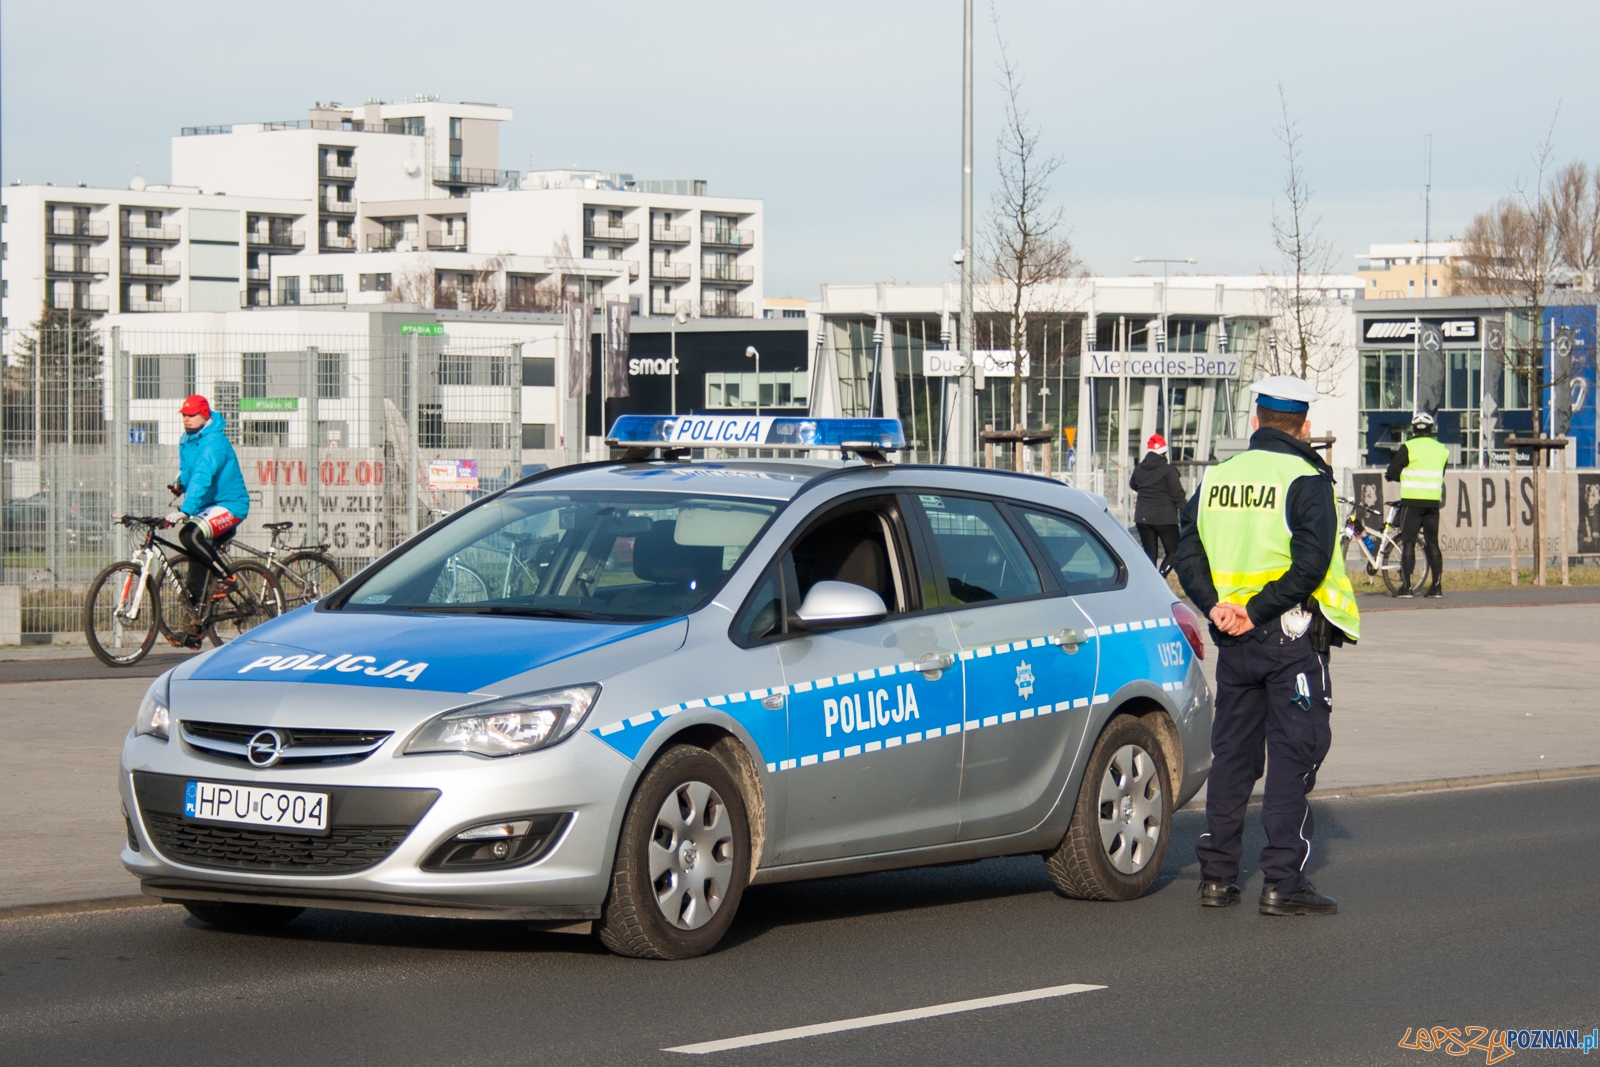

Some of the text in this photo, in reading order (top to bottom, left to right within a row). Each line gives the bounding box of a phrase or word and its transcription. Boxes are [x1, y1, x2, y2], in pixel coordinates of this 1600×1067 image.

[402, 326, 443, 334] PTASIA 10
[1400, 321, 1476, 338] AG
[628, 356, 680, 376] smart
[1089, 355, 1237, 376] Mercedes-Benz
[676, 420, 761, 442] POLICJA
[1491, 452, 1511, 461] Deale
[1207, 485, 1276, 510] POLICJA
[1440, 476, 1534, 528] APIS
[1157, 641, 1185, 667] U152
[237, 654, 429, 683] POLICJA
[823, 683, 920, 738] POLICJA
[186, 803, 195, 812] PL
